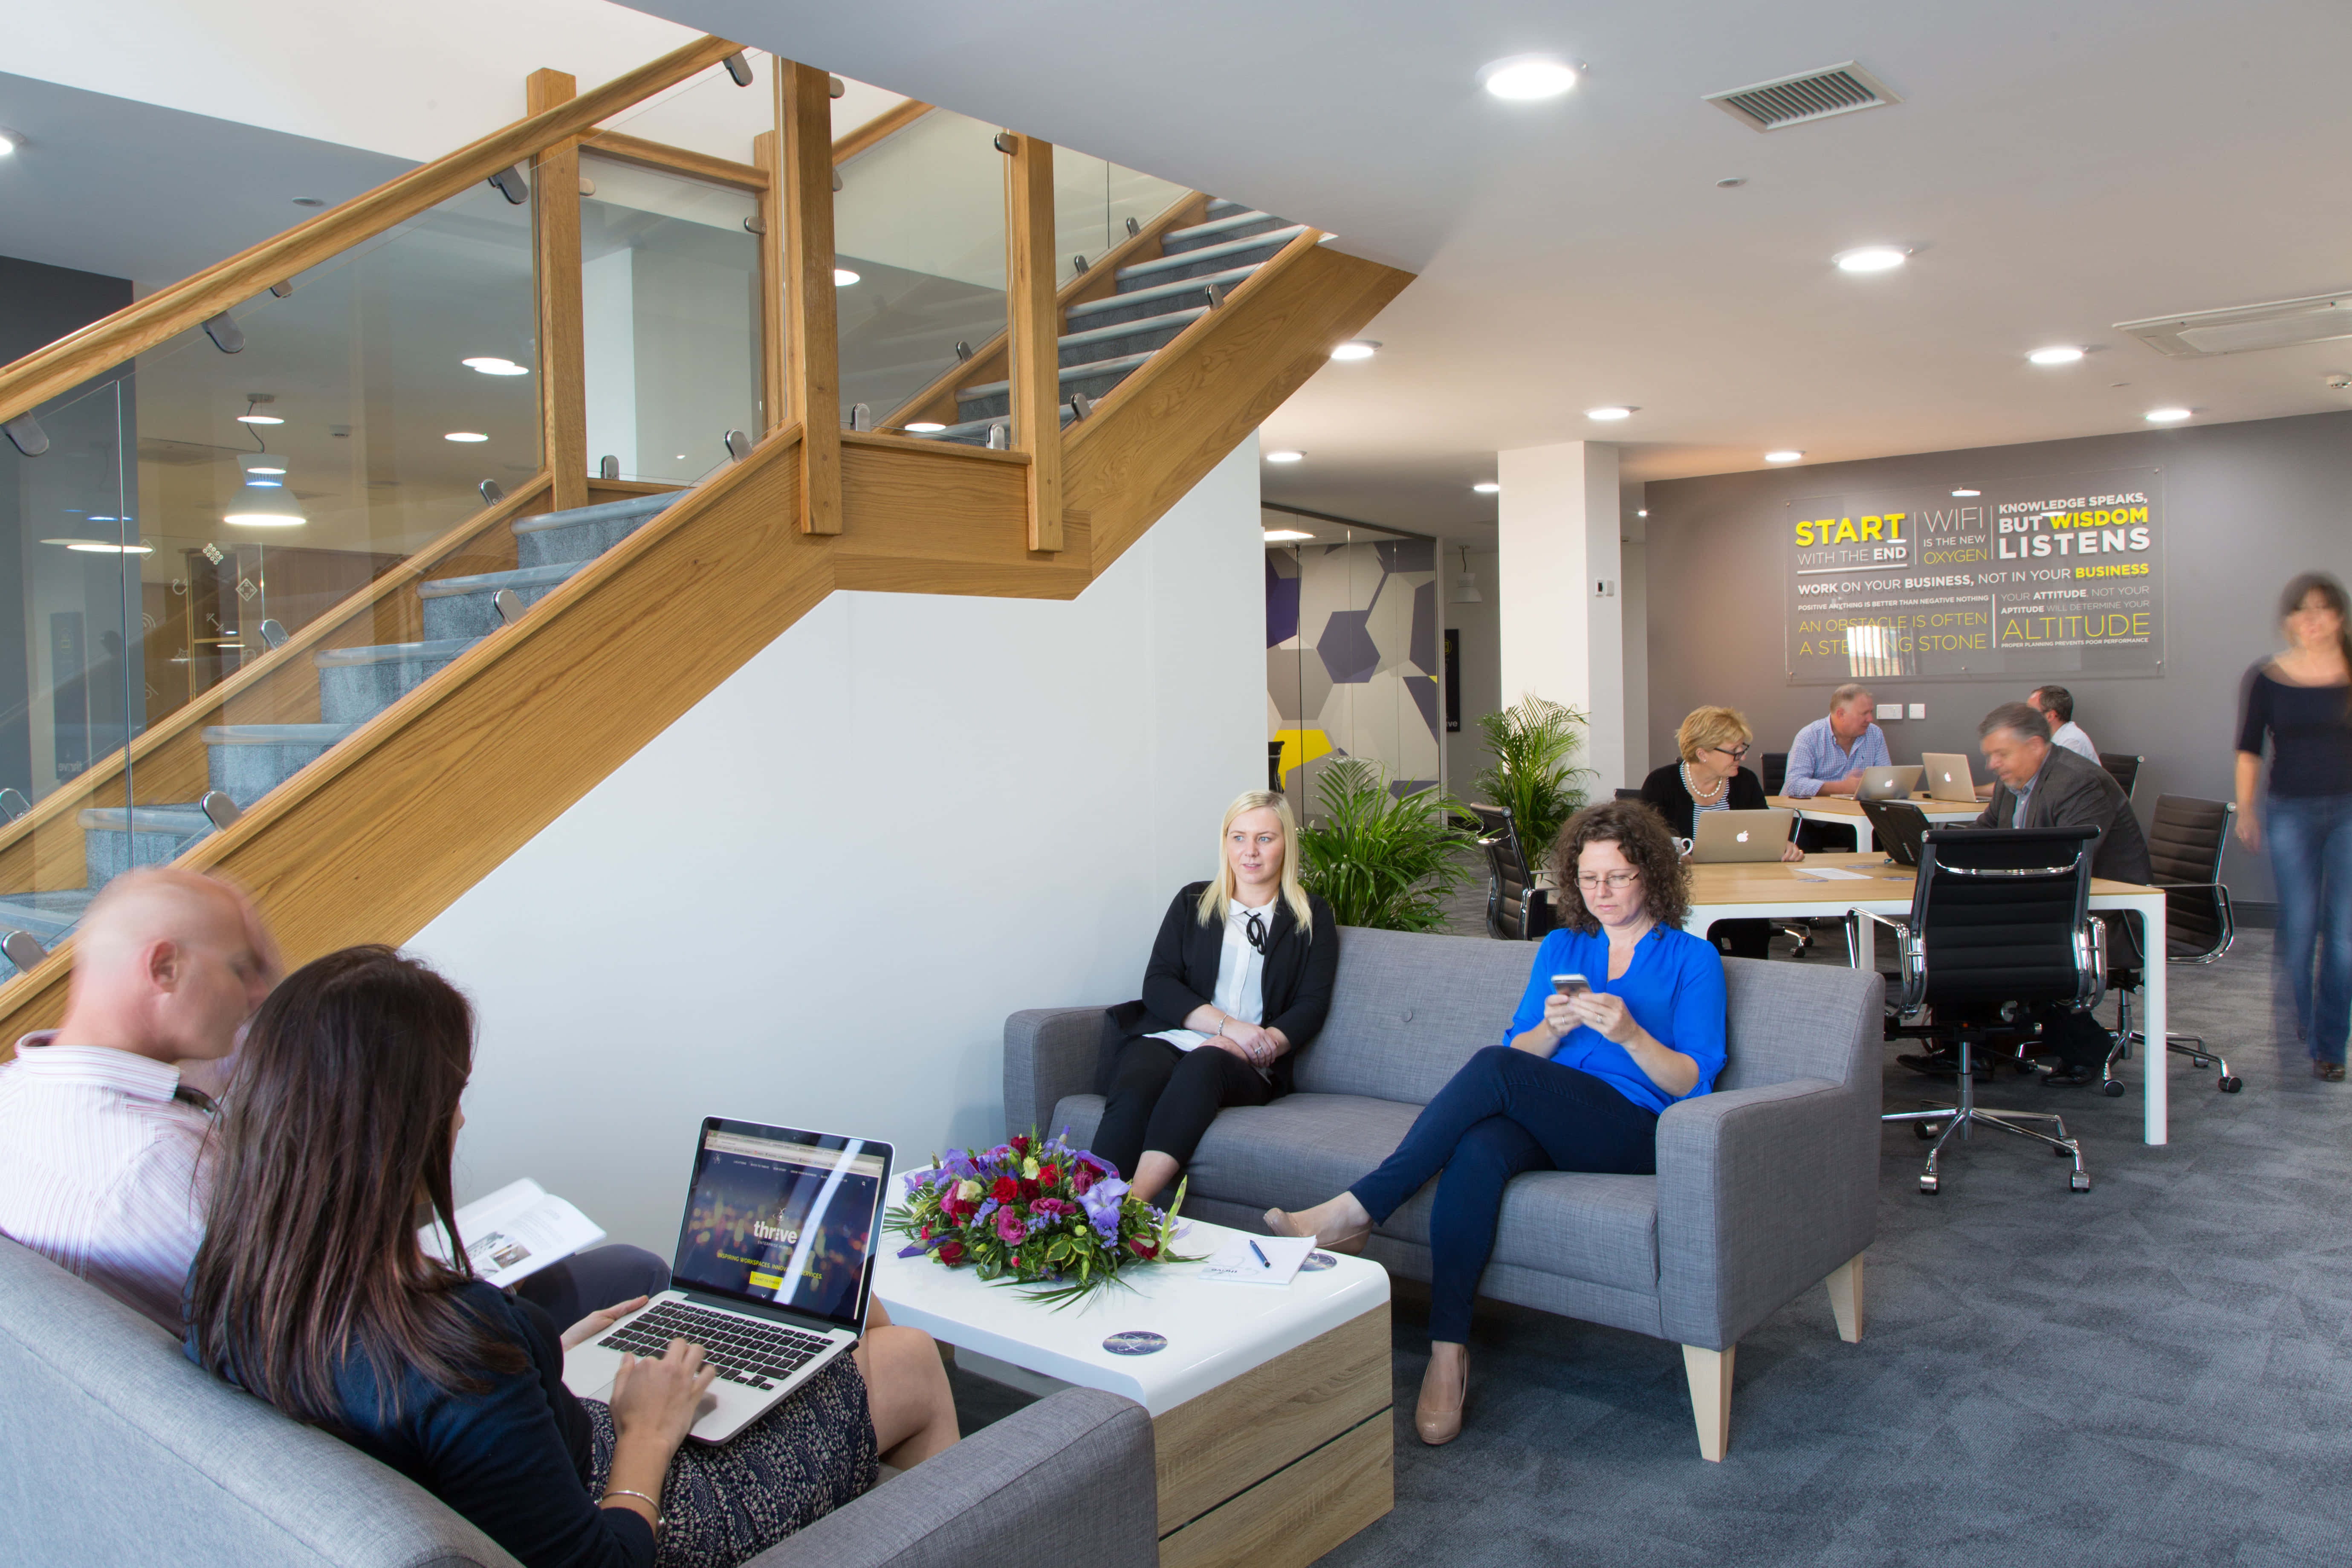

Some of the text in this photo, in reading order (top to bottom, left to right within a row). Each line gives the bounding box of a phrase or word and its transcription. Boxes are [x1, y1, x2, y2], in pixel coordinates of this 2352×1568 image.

[1999, 492, 2148, 514] KNOWLEDGE SPEAKS,
[1924, 506, 1983, 532] WIFI
[1999, 507, 2148, 533] BUT WISDOM
[1795, 513, 1905, 546] START
[1924, 535, 1985, 547] IS THE NEW
[1999, 527, 2150, 559] LISTENS
[1797, 547, 1907, 565] WITH THE END
[1924, 548, 1987, 564] OXYGEN
[1798, 563, 2149, 595] WORK ON YOUR BUSINESS, NOT IN YOUR BUSINESS
[2001, 593, 2030, 602] YOUR
[2092, 587, 2115, 596] NOT
[2118, 586, 2149, 595] YOUR
[1828, 602, 1863, 610] ANYTHING
[2001, 605, 2045, 614] APTITUDE
[2070, 601, 2122, 610] DETERMINE
[1799, 612, 1987, 632] AN OBSTACLE IS OFTEN
[2002, 613, 2150, 640] ALTITUDE
[1799, 634, 1987, 655] A STENG STONE
[717, 1253, 739, 1261] INSPIRING
